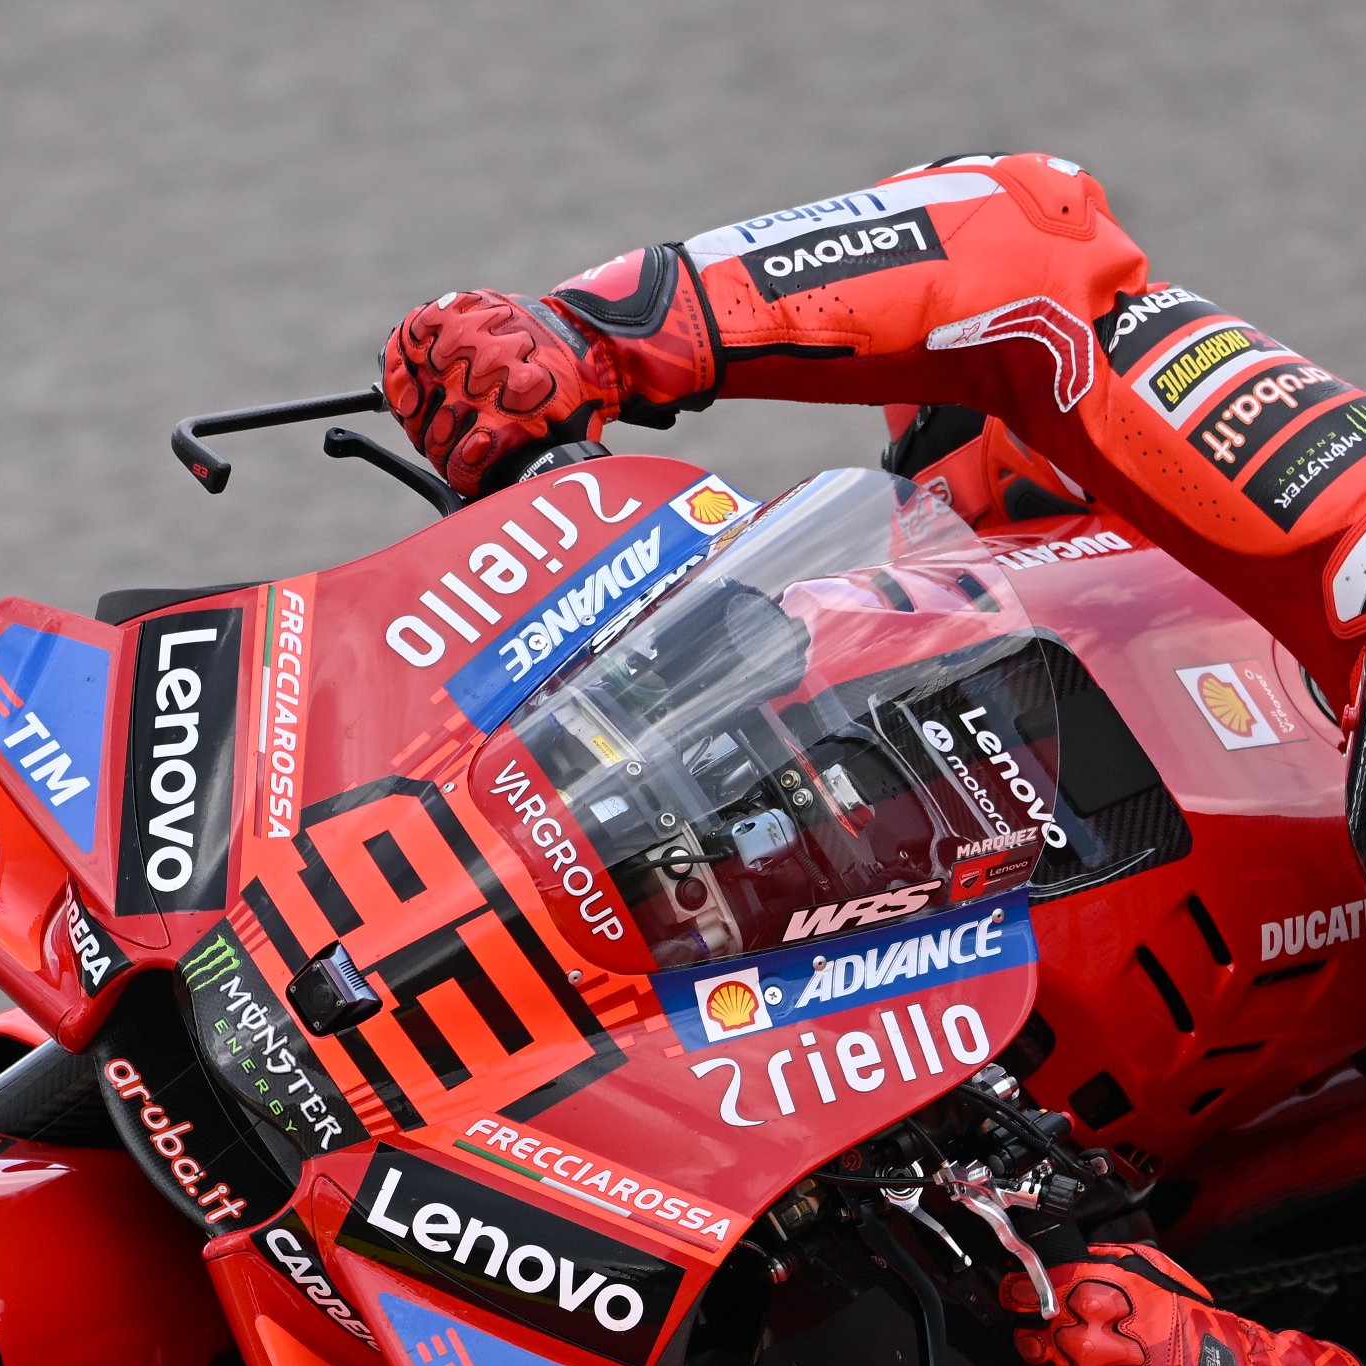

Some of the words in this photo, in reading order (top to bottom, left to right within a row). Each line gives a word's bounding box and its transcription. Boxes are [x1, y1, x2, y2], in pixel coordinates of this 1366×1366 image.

[763, 221, 928, 277] Lenovo
[1201, 367, 1335, 464] aruba.it
[1277, 431, 1337, 486] ENERGY
[192, 463, 209, 479] 93
[1274, 431, 1362, 510] MONSTER
[995, 531, 1133, 571] DUCATI
[499, 523, 661, 683] ADVANCE
[2, 713, 91, 807] TIM
[146, 627, 218, 893] Lenovo
[267, 588, 305, 840] FRECCIAROSSA
[946, 755, 1020, 850] motoro
[959, 706, 1068, 849] Lenovo
[489, 758, 624, 943] VARGROUP
[956, 827, 1039, 860] MARQUEZ
[989, 859, 1029, 878] Lenovo
[782, 880, 942, 942] WRS
[794, 918, 1003, 1009] ADVANCE
[215, 1017, 299, 1135] ENERGY
[220, 974, 343, 1151] MONSTER
[104, 1057, 248, 1225] aruba.it
[462, 1117, 734, 1243] FRECCIAROSSA
[365, 1166, 645, 1332] Lenovo
